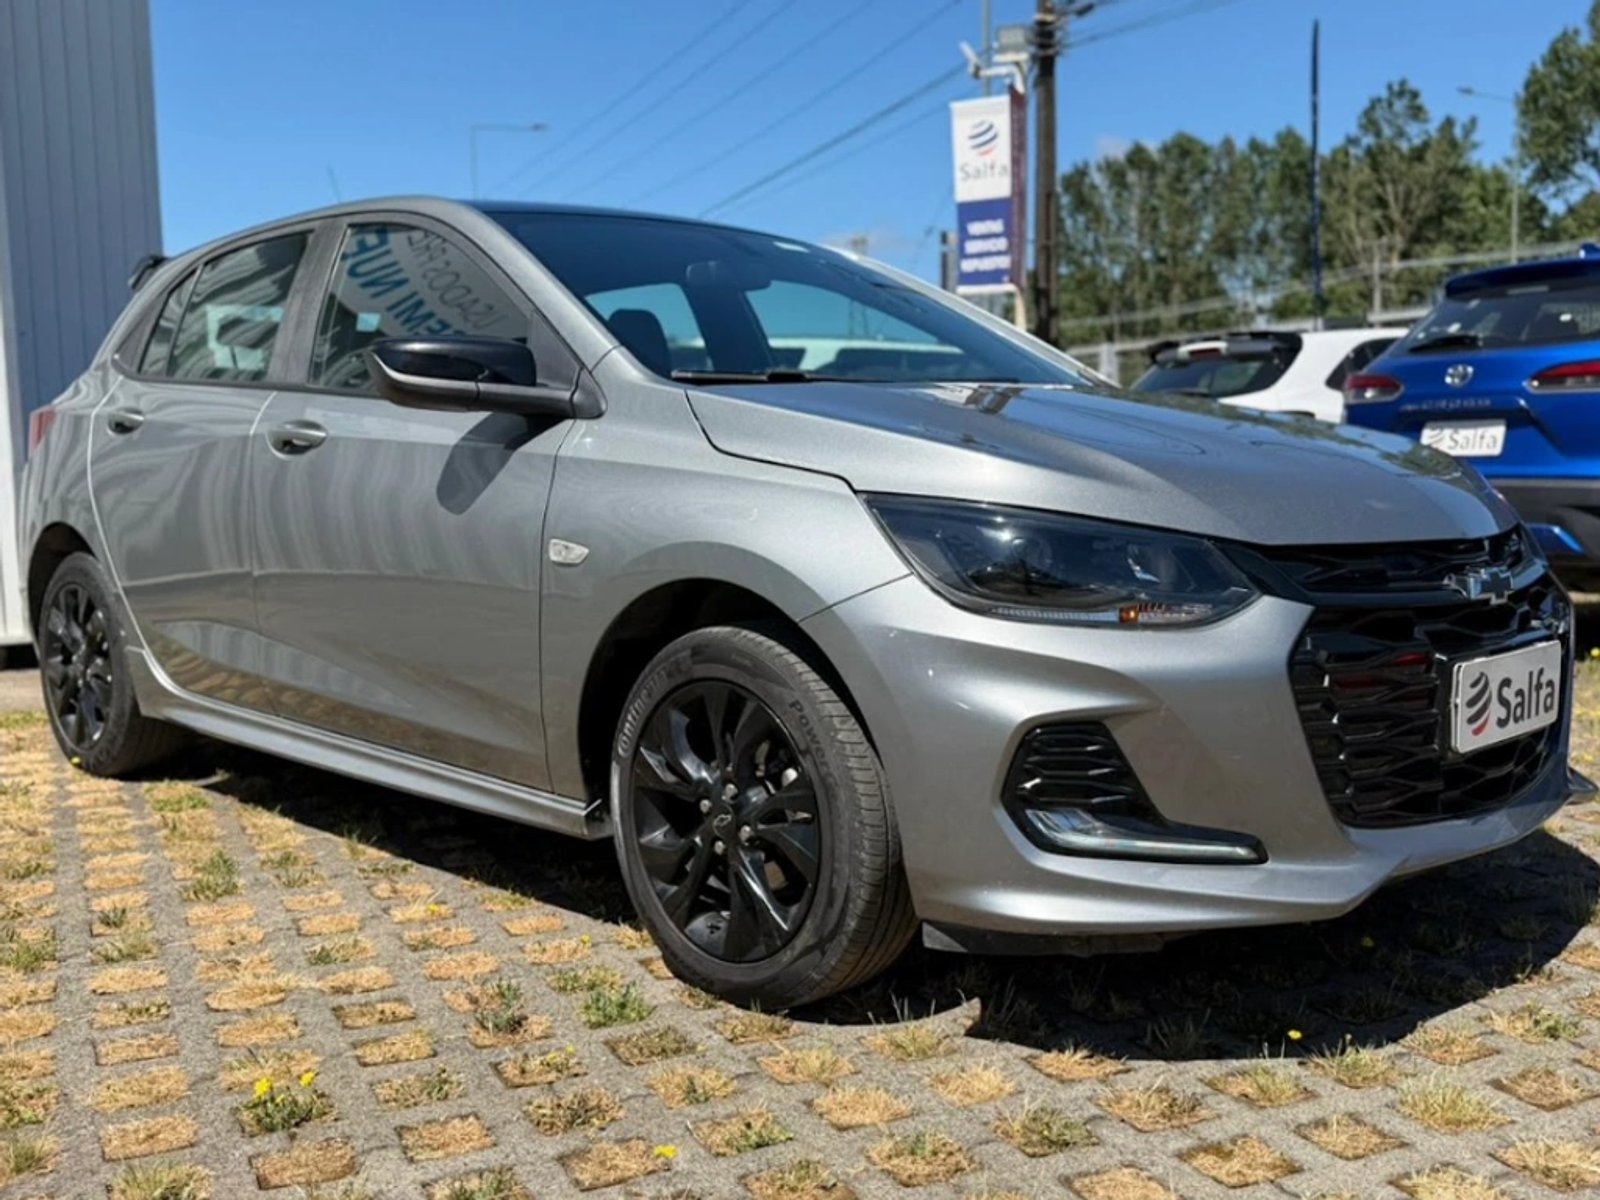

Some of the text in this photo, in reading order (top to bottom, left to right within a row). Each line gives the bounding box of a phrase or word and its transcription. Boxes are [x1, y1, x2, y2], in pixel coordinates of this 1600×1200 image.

[960, 161, 1009, 182] Salfa
[1447, 427, 1499, 451] Salfa
[1496, 667, 1555, 729] Salfa
